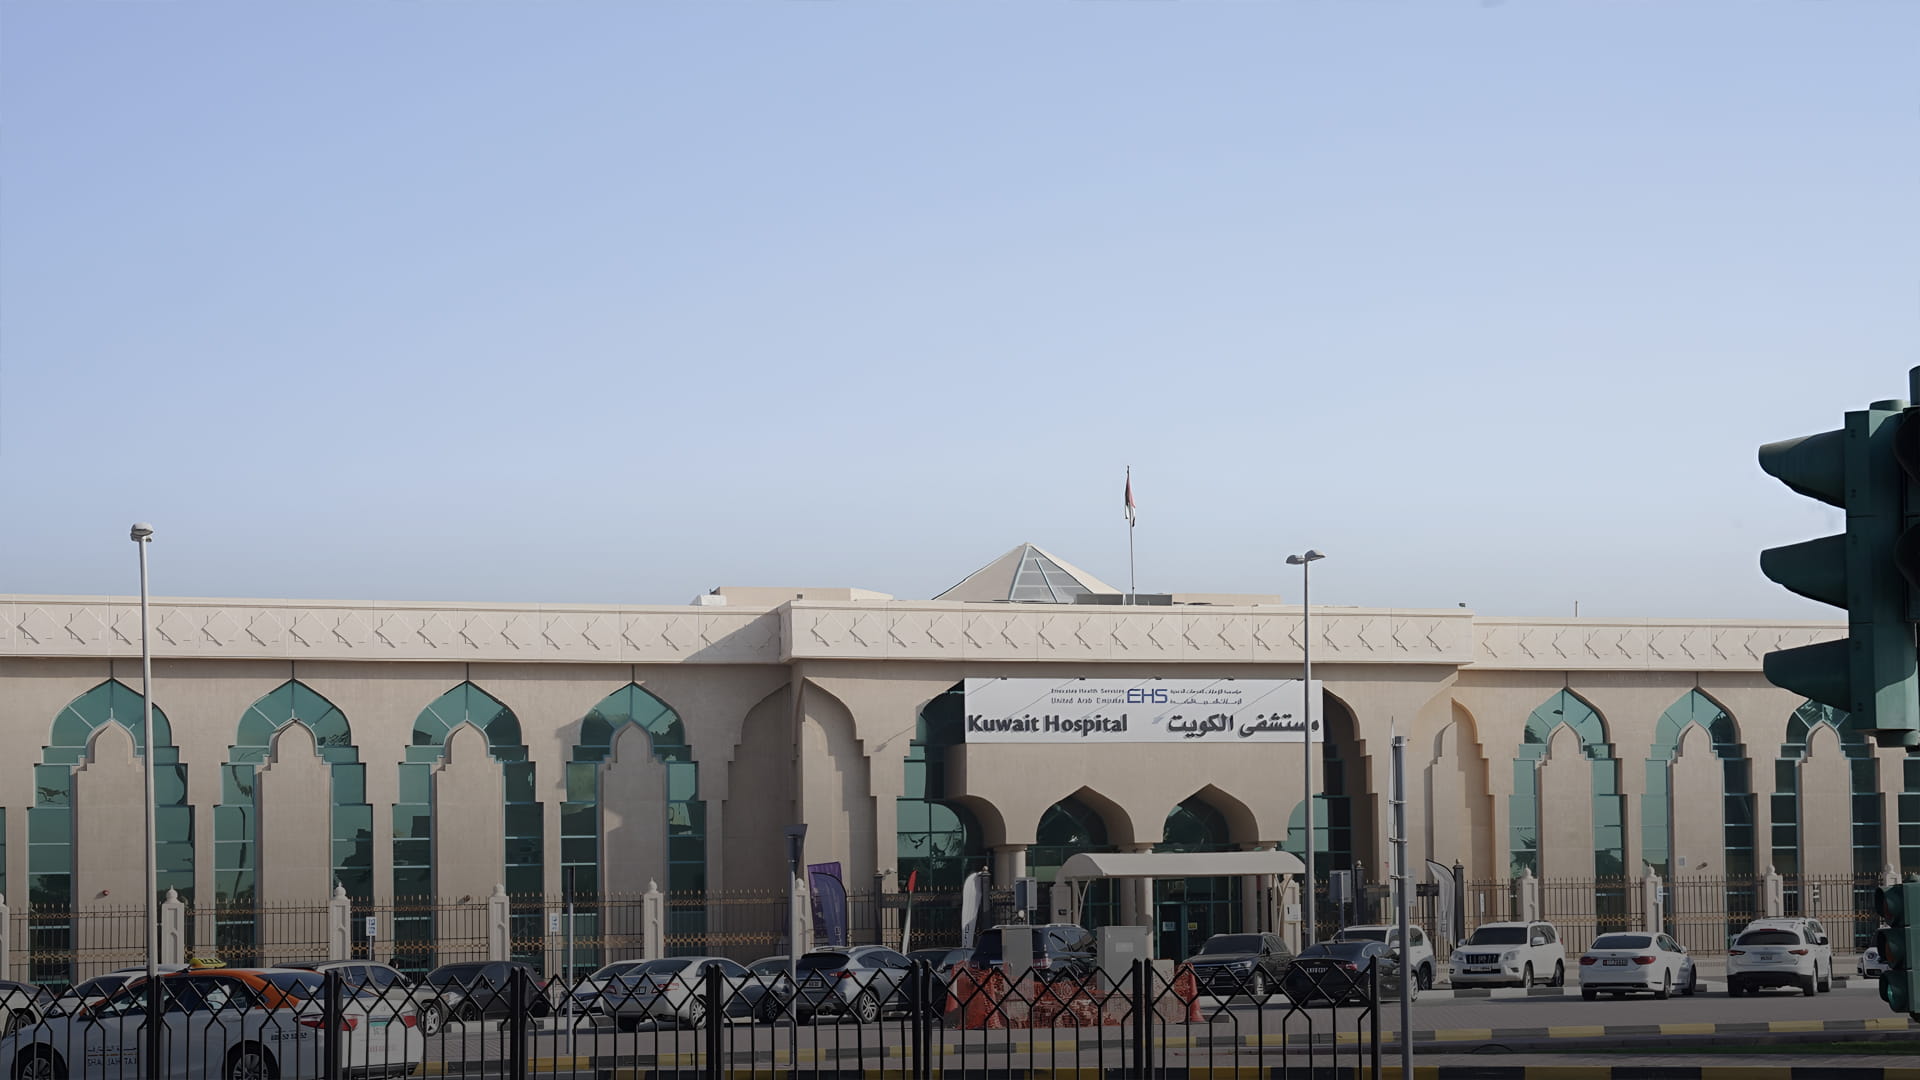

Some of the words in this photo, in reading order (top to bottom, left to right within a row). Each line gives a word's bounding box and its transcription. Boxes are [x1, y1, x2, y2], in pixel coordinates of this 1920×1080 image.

[1127, 688, 1168, 704] EHS
[967, 714, 1040, 732] Kuwait
[1044, 713, 1128, 737] Hospital
[1168, 713, 1234, 738] الكويت
